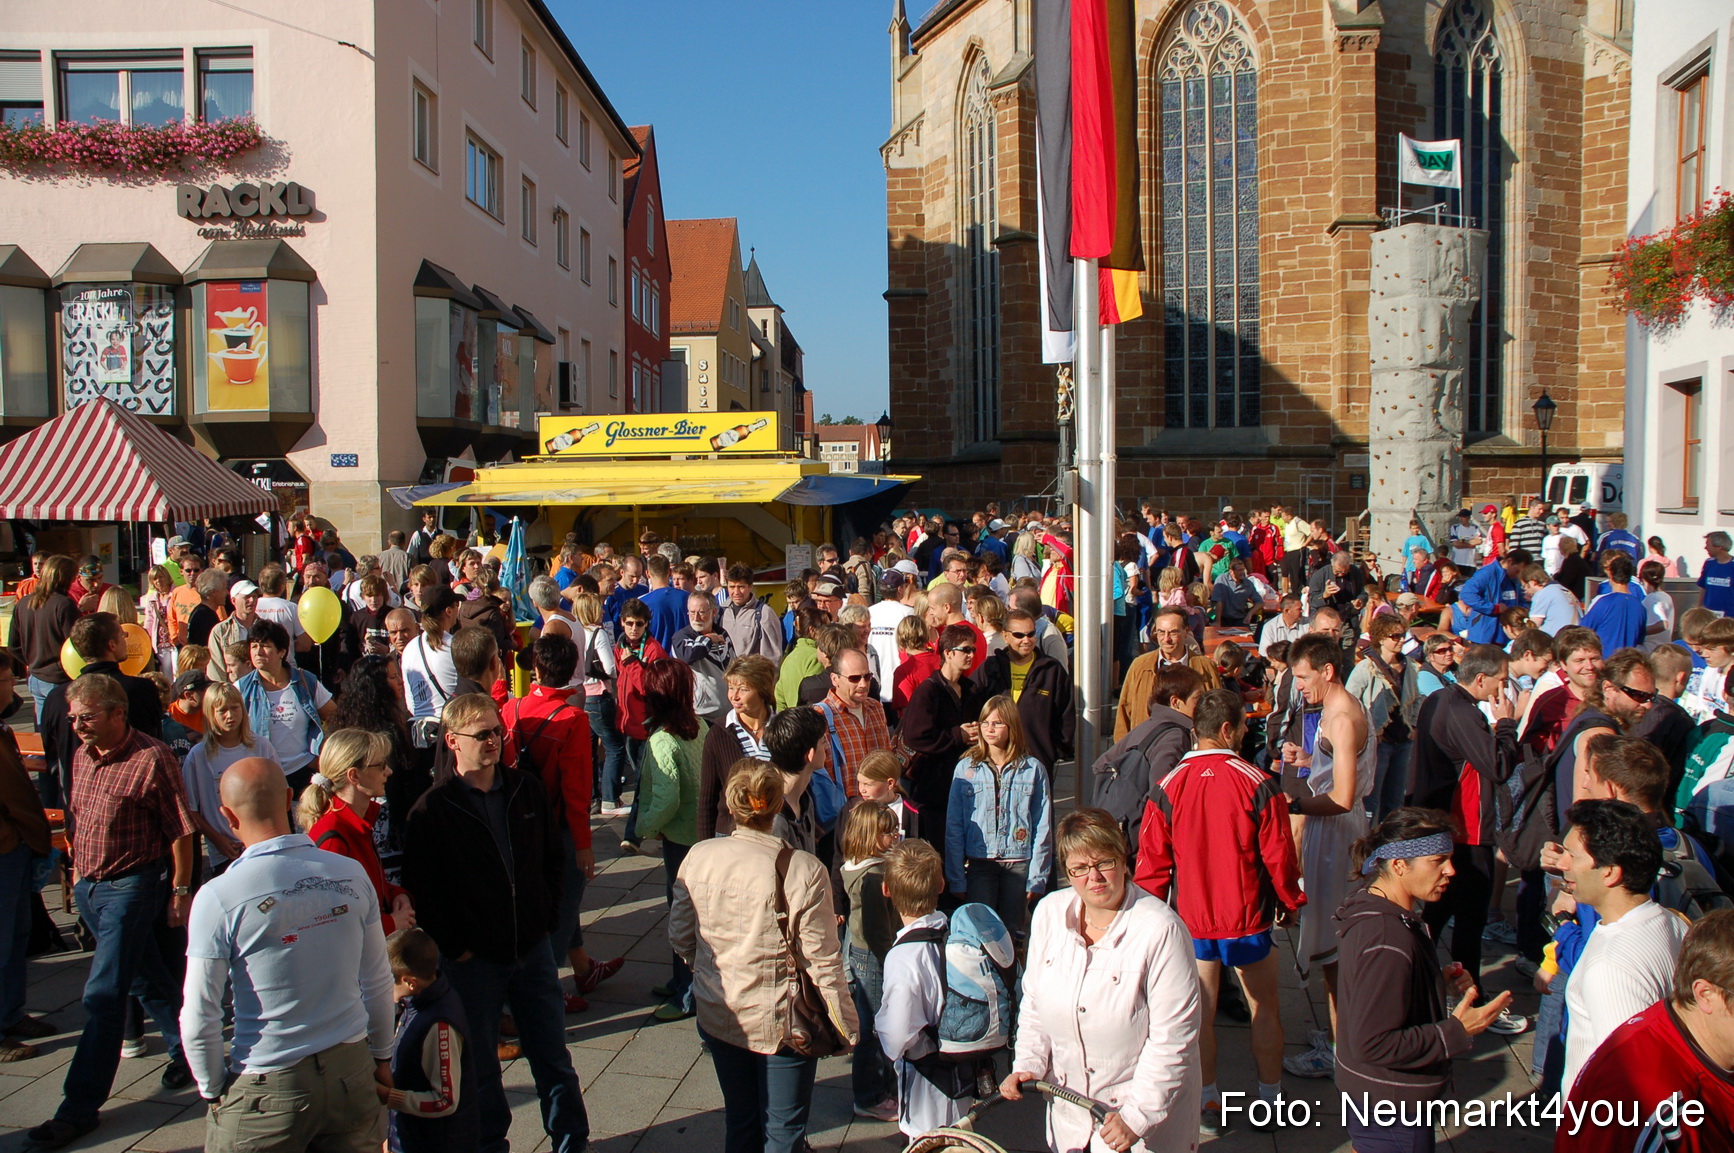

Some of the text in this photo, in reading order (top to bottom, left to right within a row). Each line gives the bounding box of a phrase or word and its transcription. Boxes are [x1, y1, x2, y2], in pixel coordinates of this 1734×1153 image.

[177, 182, 312, 219] RACKL
[97, 288, 123, 300] Jahre
[698, 359, 709, 409] satz
[605, 419, 707, 448] Glossner-Bier
[246, 477, 271, 491] ACKL
